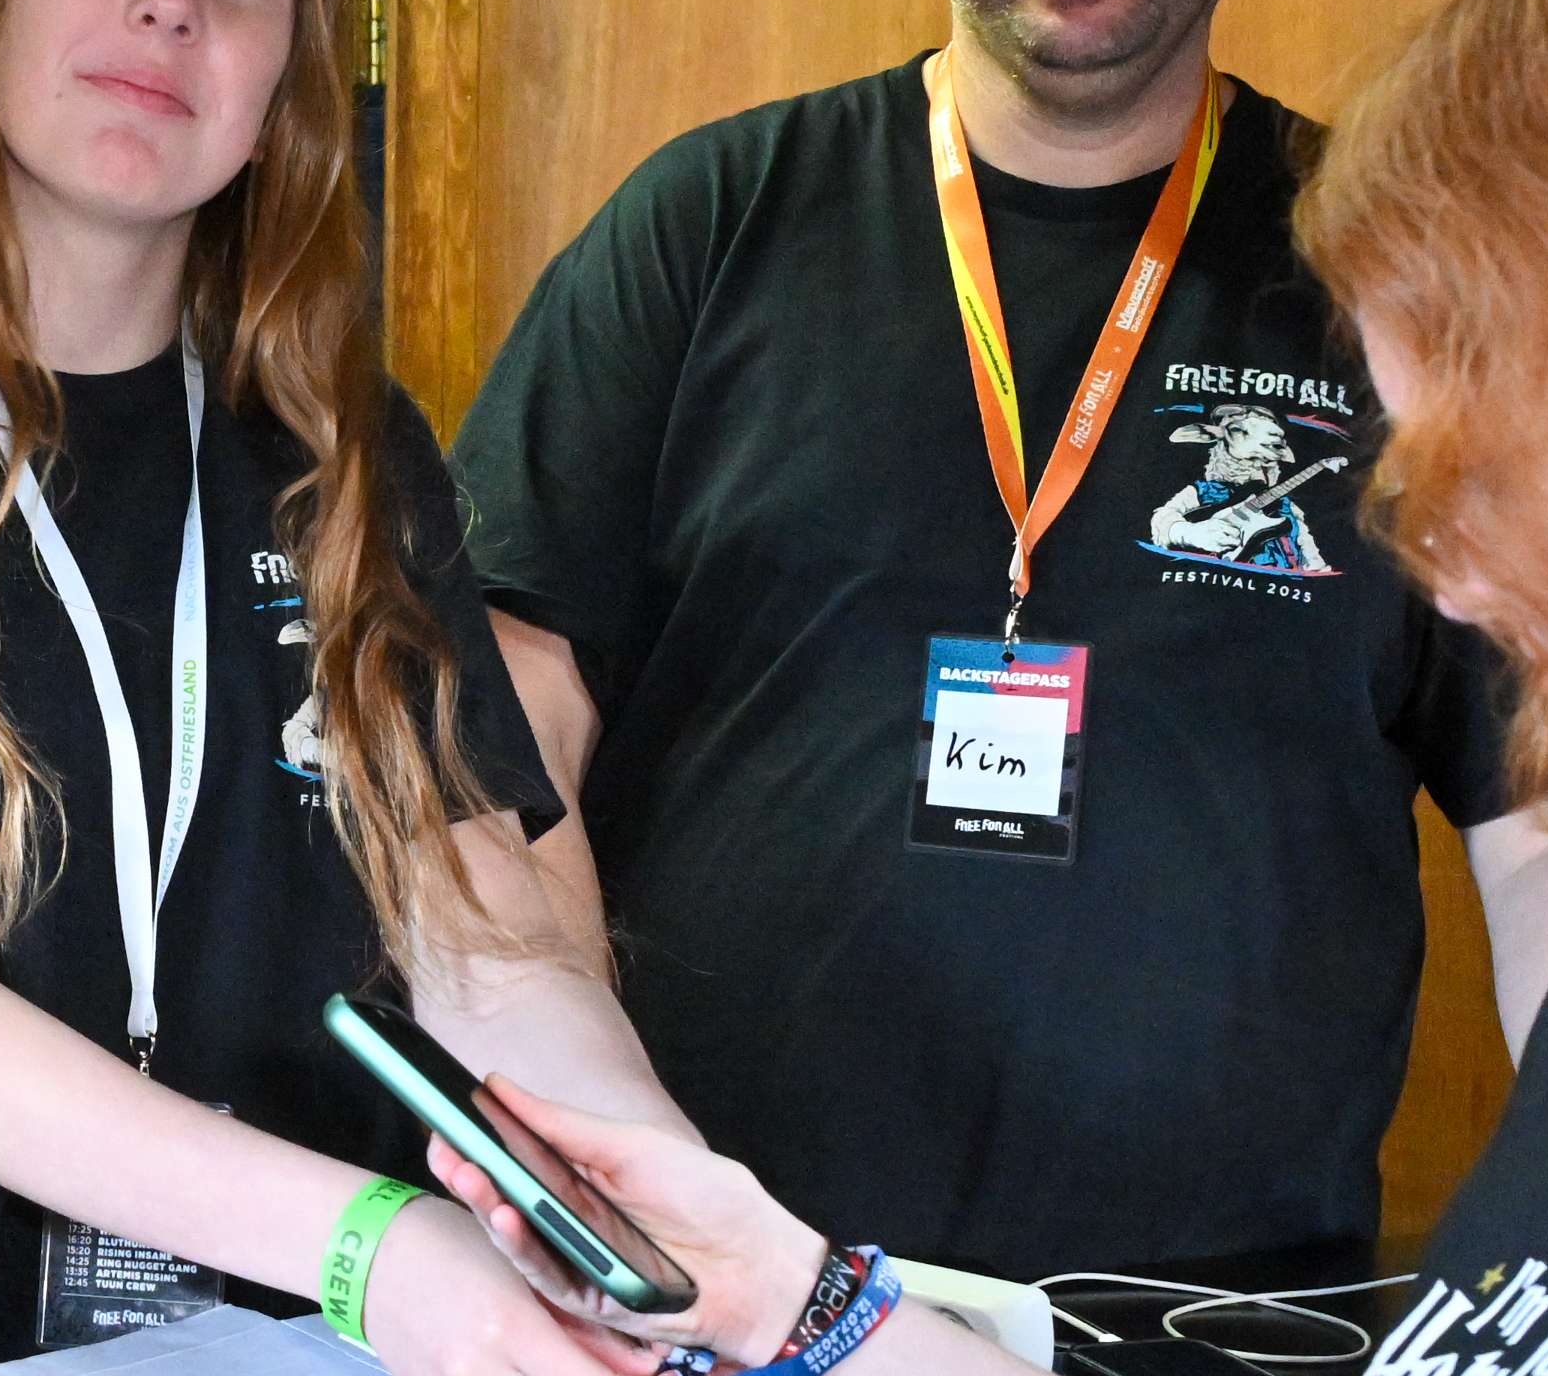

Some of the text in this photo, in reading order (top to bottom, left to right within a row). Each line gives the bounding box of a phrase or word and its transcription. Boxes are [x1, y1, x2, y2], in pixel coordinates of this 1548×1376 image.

[1165, 363, 1354, 416] FREE FOR ALL
[1161, 571, 1312, 603] FESTIVAL 2025
[939, 667, 1071, 689] BACKSTAGEPASS
[179, 659, 197, 791] OSTFRIESLAND
[946, 731, 1026, 777] Kim
[172, 794, 189, 833] AUS
[955, 818, 981, 832] FREE
[1003, 822, 1024, 835] ALL
[66, 1256, 197, 1274] 14:25 KING NUGGET GANG
[67, 1246, 91, 1255] 15:20
[98, 1249, 132, 1259] RISING
[64, 1278, 88, 1287] 12:45
[125, 1281, 156, 1292] CREW
[96, 1269, 141, 1280] ARTEMIS
[143, 1273, 178, 1283] RISING
[328, 1230, 363, 1325] CREW
[92, 1309, 122, 1325] FREE
[804, 1297, 872, 1366] 12.07.2025
[808, 1307, 880, 1374] FESTIVAL
